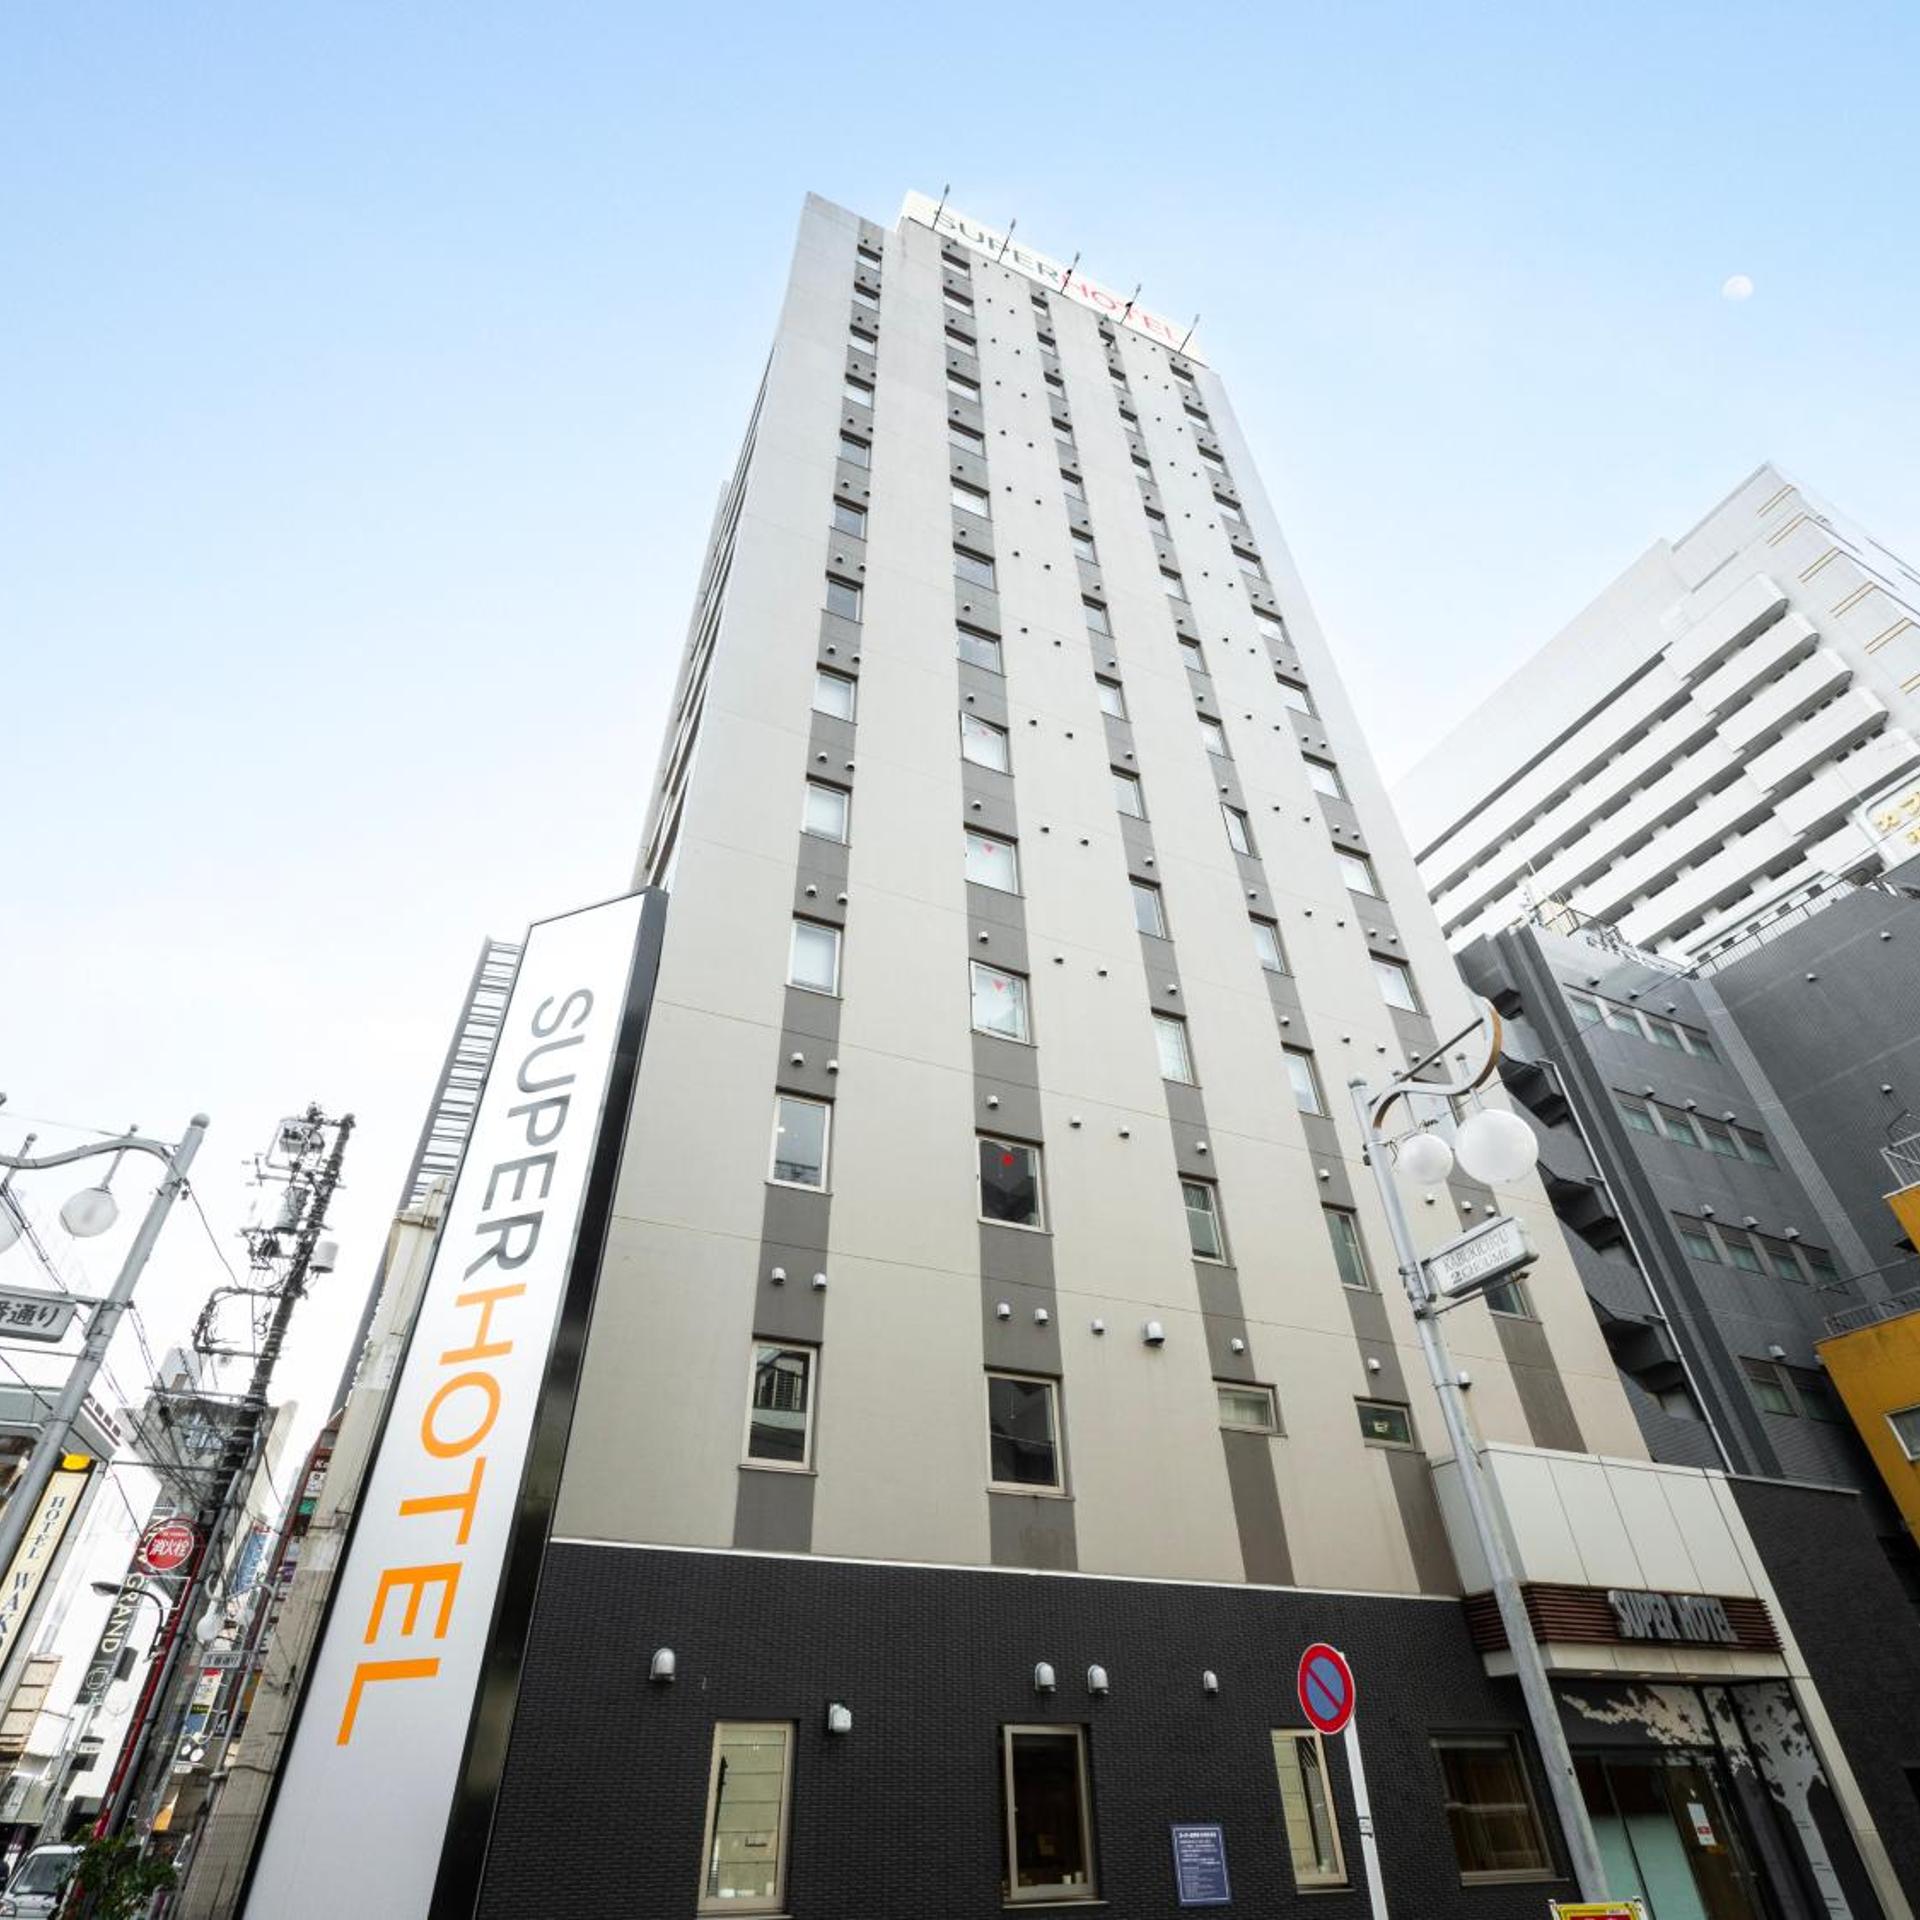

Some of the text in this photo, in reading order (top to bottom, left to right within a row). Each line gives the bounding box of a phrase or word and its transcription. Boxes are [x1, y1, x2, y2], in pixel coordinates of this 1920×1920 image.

[0, 1496, 66, 1649] HOTEL WAK
[149, 1538, 190, 1557] 消火栓
[101, 1573, 145, 1653] GRAND
[1608, 1590, 1738, 1642] SUPER HOTEL
